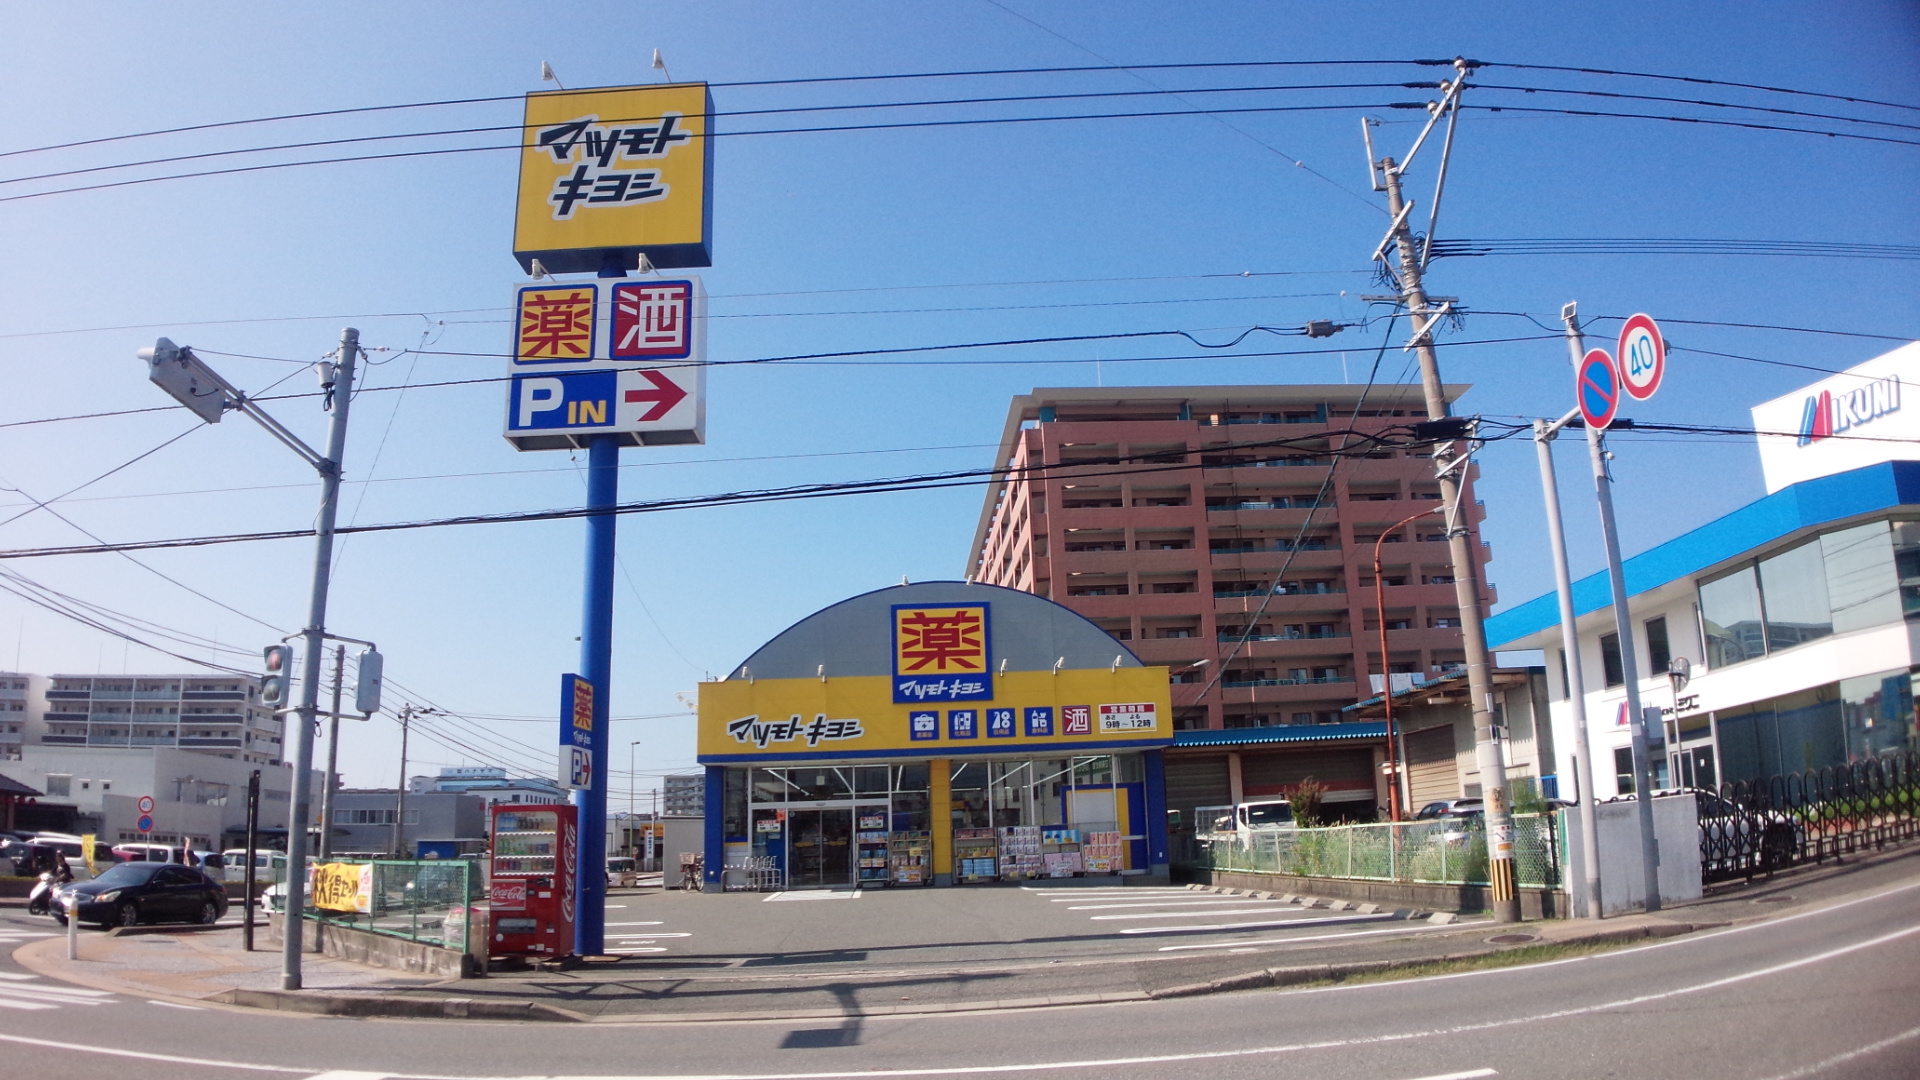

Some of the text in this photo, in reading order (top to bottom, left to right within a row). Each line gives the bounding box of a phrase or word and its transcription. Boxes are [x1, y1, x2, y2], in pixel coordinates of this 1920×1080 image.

[537, 113, 689, 169] マツモト
[550, 163, 666, 217] キヨシ
[522, 292, 591, 358] 薬
[617, 287, 685, 350] 酒
[1630, 335, 1654, 377] 40
[518, 376, 607, 427] P IN
[901, 610, 981, 671] 薬
[575, 682, 592, 729] 薬
[899, 679, 985, 700] マツモトキヨシ
[728, 714, 863, 748] マツモトキヨシ
[1065, 708, 1089, 732] 酒
[491, 886, 526, 900] Coca-Cola
[561, 818, 576, 923] Coca-Cola
